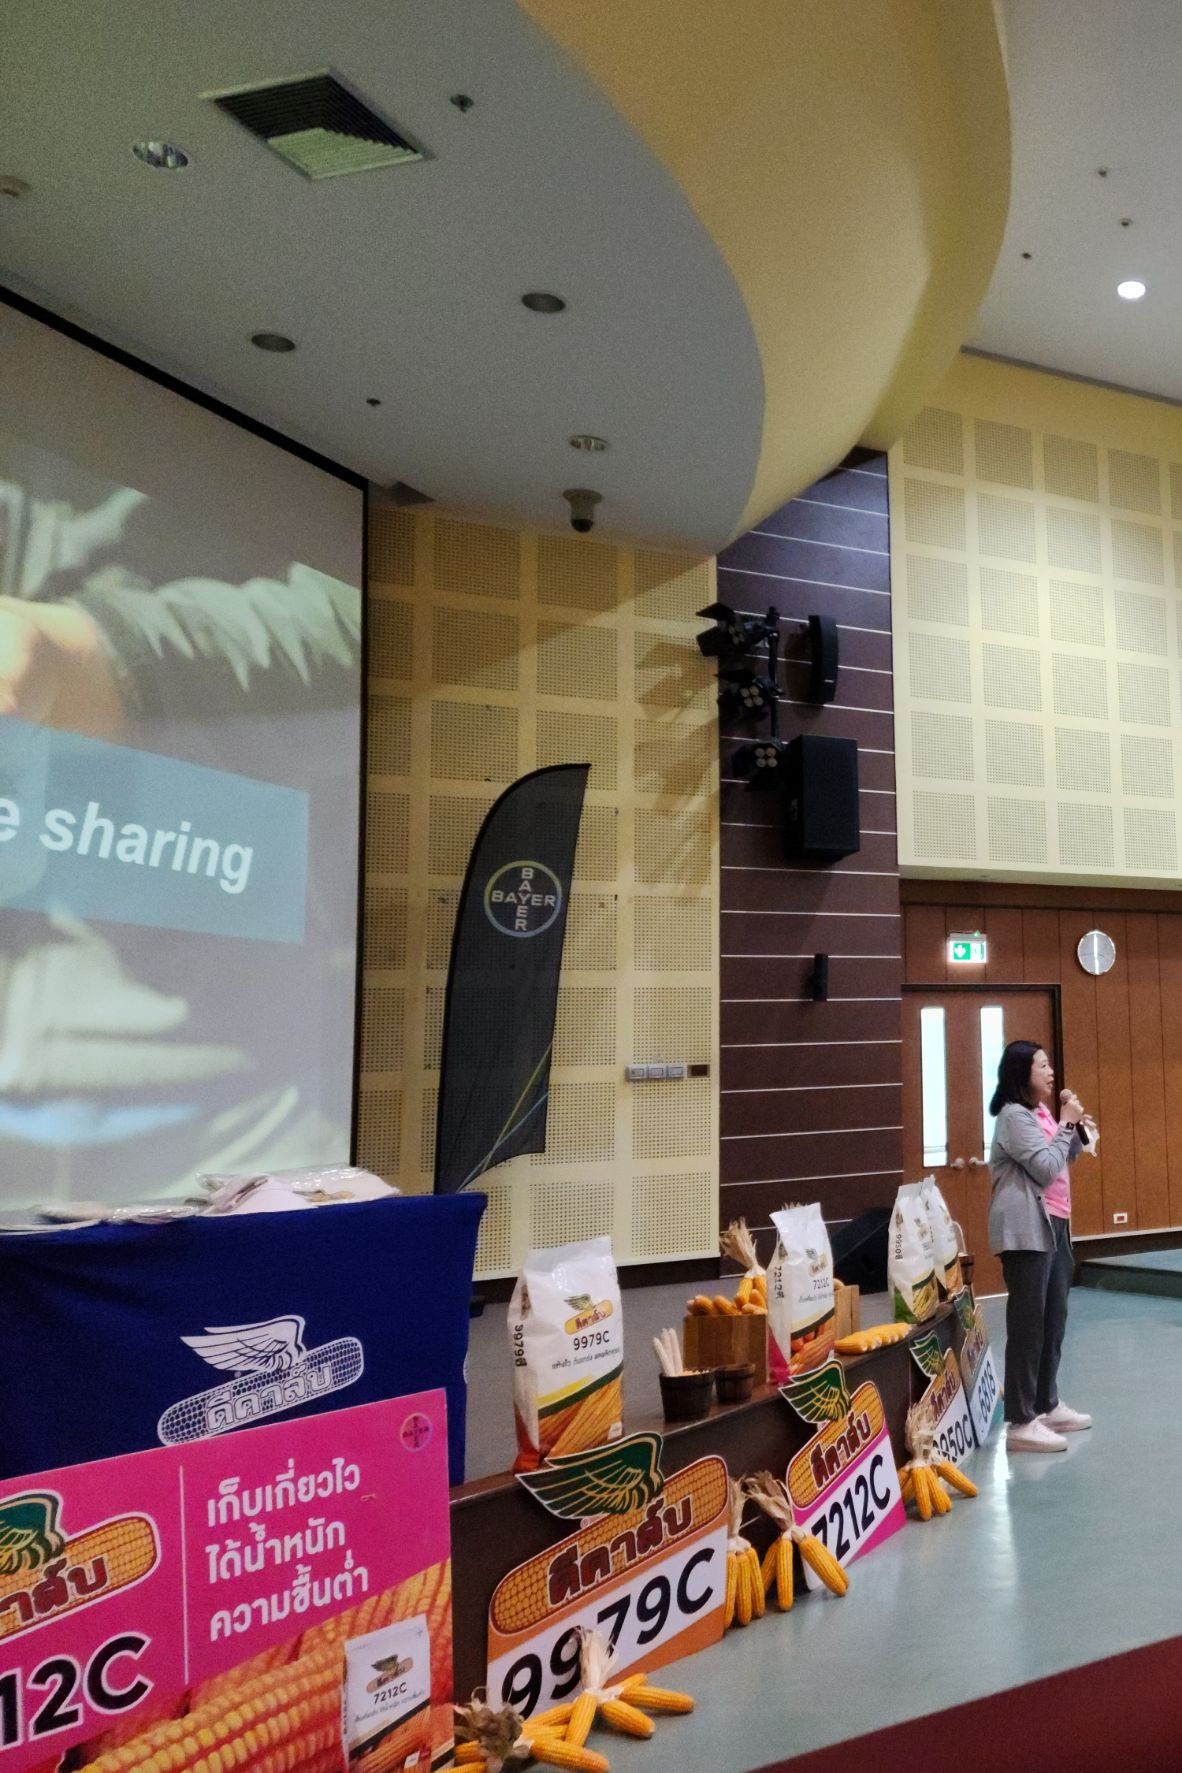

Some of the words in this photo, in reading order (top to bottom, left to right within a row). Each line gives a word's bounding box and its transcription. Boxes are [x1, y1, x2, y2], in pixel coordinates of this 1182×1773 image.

[39, 801, 254, 895] sharing
[491, 890, 557, 908] BAYER
[514, 867, 535, 932] BAYER
[573, 1330, 610, 1351] 9979C
[932, 1414, 973, 1464] 950C
[207, 1457, 362, 1528] เก็บเกี่ยวไว
[811, 1454, 891, 1561] 7212C
[205, 1516, 347, 1585] ได้น้ำหนัก
[209, 1548, 370, 1643] ความชื้นต่ำ
[502, 1547, 716, 1721] 9979C
[373, 1681, 408, 1705] 7212C
